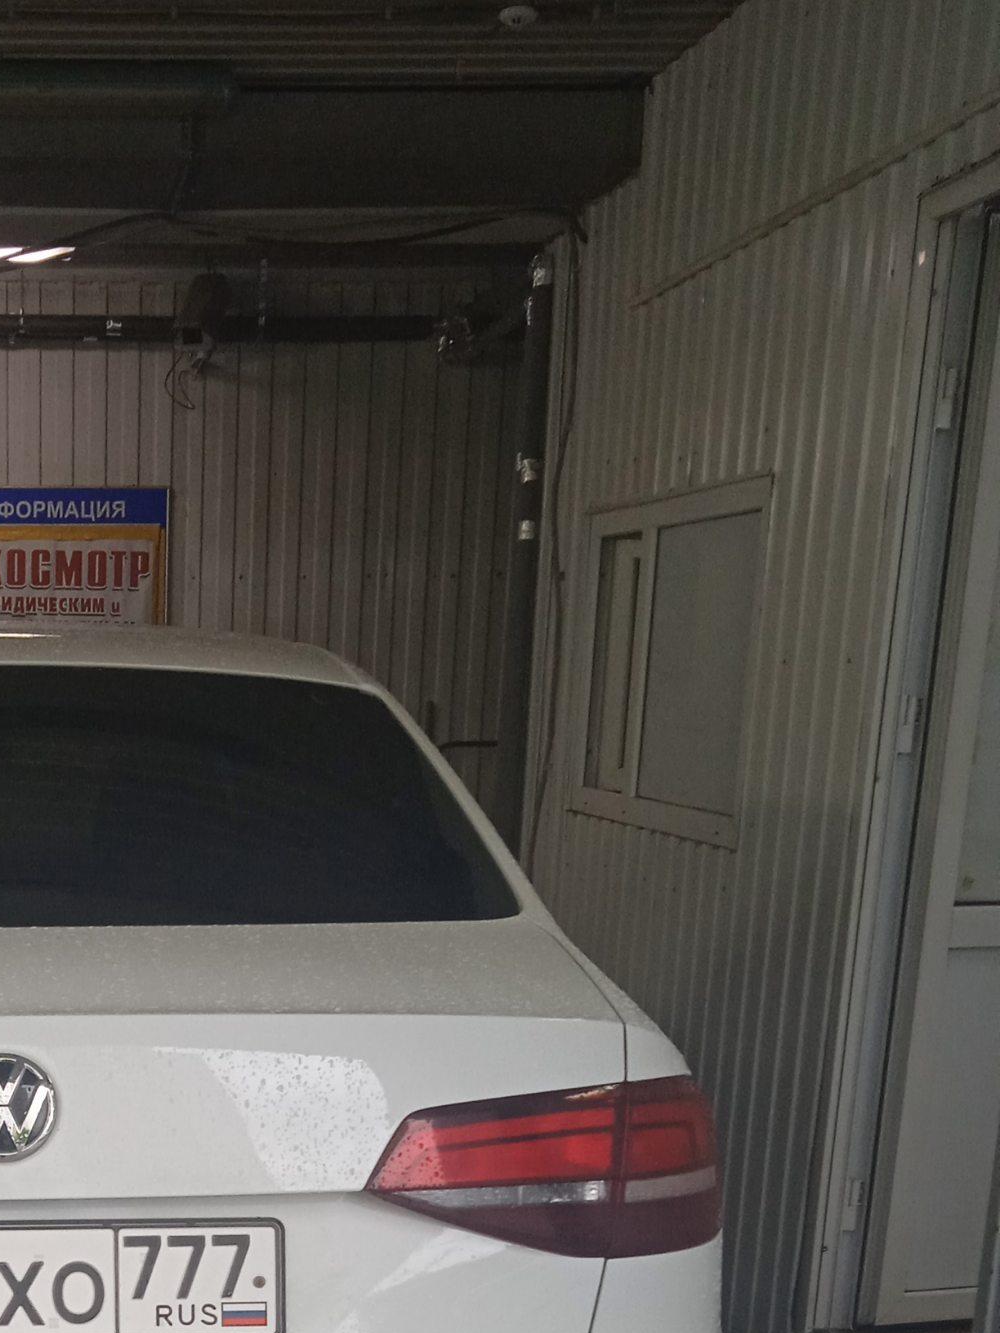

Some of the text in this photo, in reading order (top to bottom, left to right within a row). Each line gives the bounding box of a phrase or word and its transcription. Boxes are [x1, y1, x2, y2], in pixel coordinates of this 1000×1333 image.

[111, 601, 122, 616] и
[123, 1234, 251, 1300] 777
[155, 1304, 217, 1327] RUS
